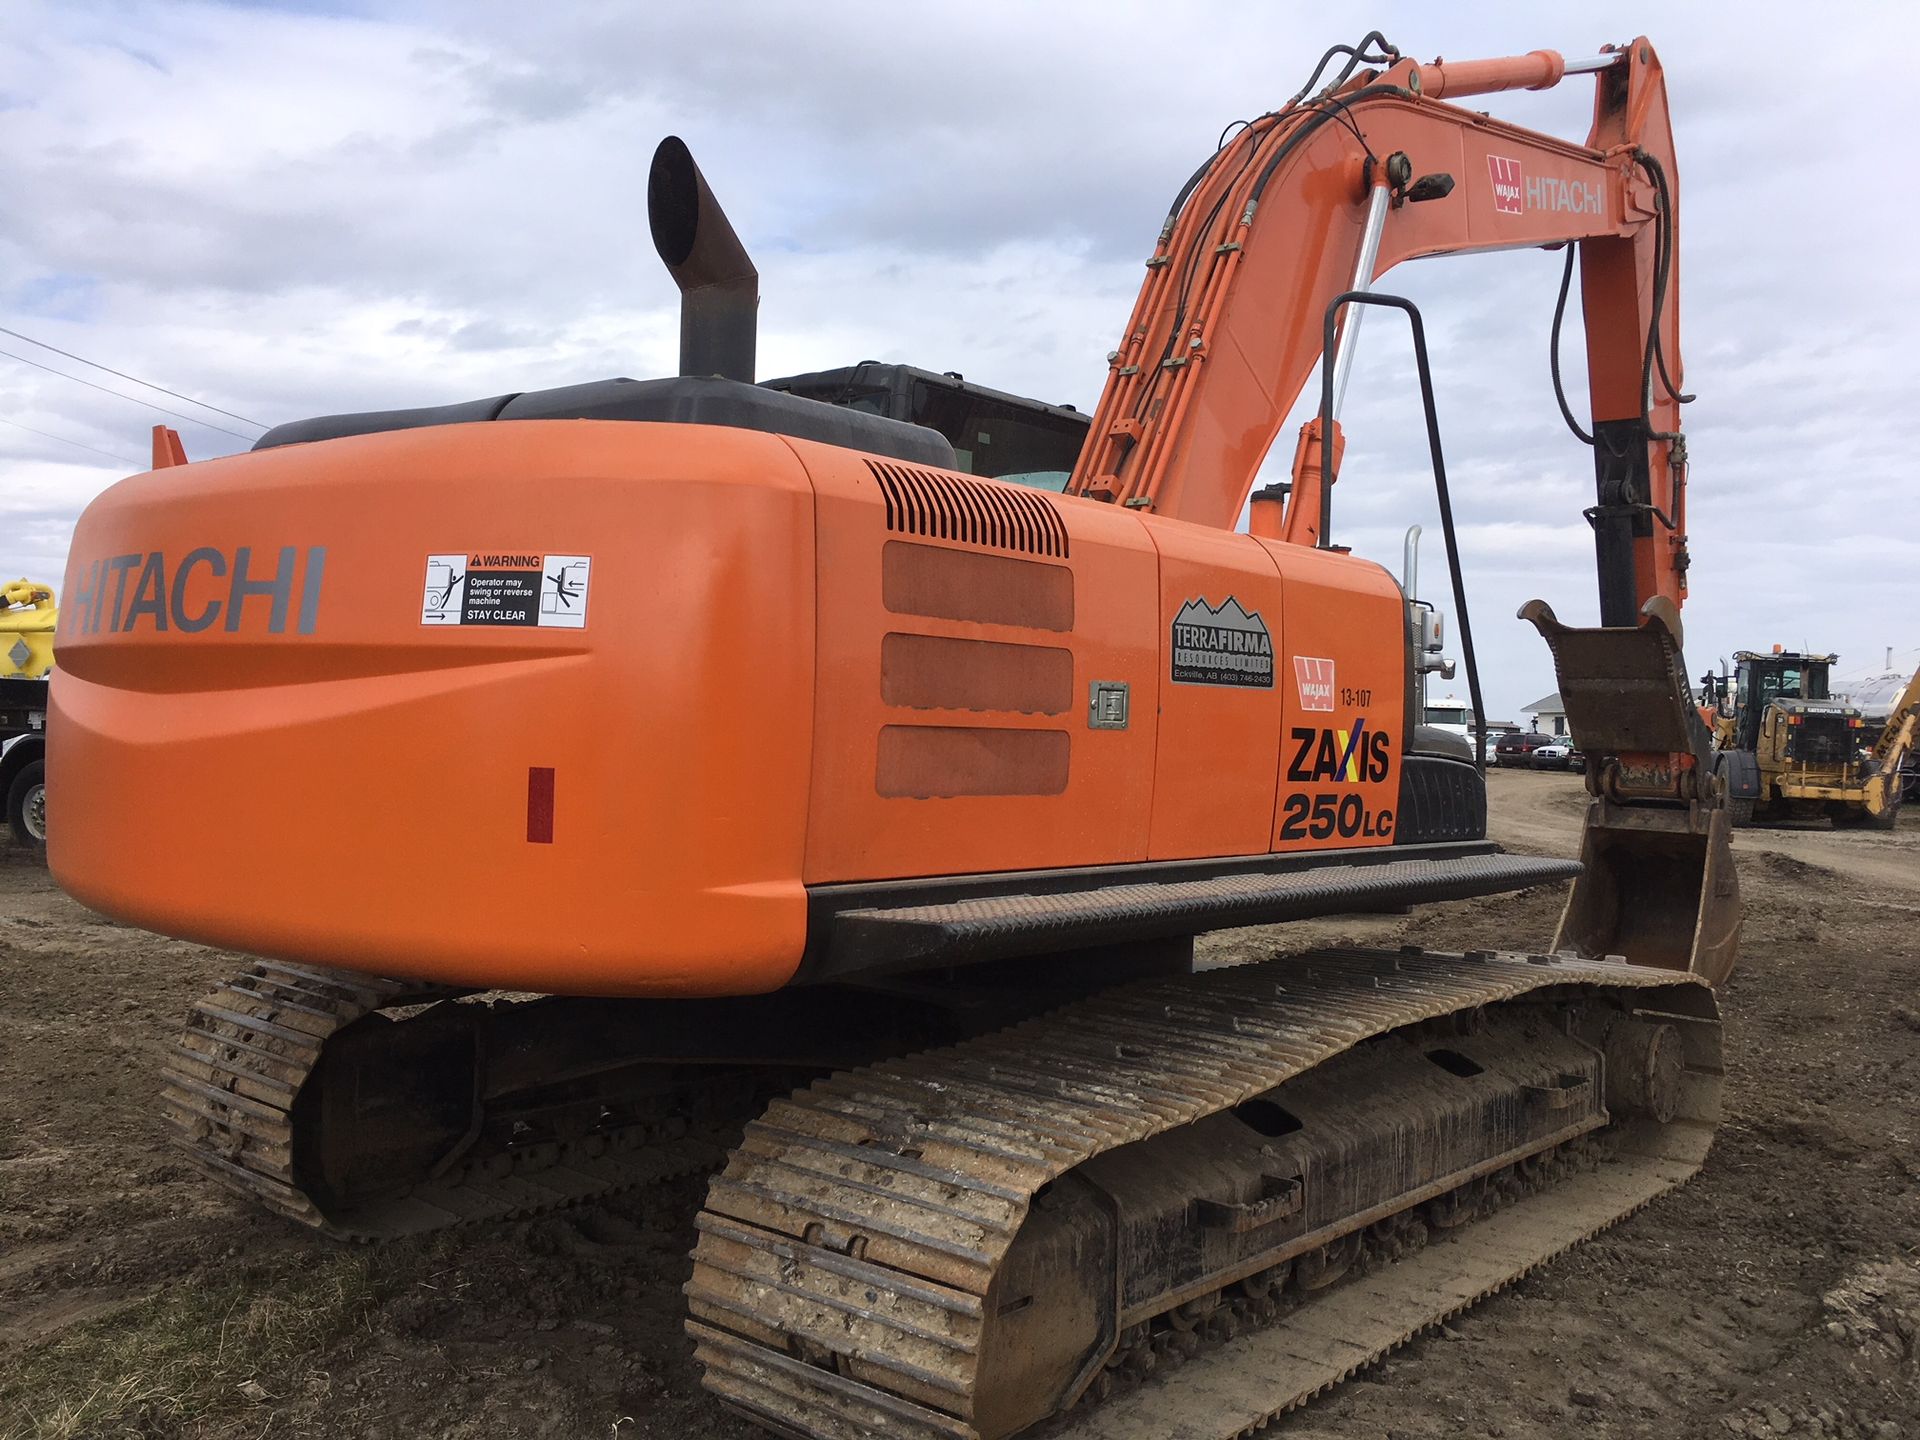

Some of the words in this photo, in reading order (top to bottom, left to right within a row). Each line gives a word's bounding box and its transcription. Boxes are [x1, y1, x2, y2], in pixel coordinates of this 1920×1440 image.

[1495, 183, 1520, 202] WAJAX
[1525, 176, 1602, 215] HITACHI
[483, 555, 540, 568] WARNING
[67, 546, 327, 635] HITACHI
[471, 578, 504, 587] Operator
[505, 579, 522, 587] may
[469, 588, 492, 597] swing
[503, 589, 533, 597] reverse
[469, 597, 501, 605] machine
[467, 610, 491, 620] STAY
[493, 611, 526, 621] CLEAR
[1175, 625, 1271, 654] TERRAFIRMA
[1177, 652, 1229, 666] RESOURCES
[1206, 672, 1218, 680] AB
[1220, 673, 1238, 682] (403)
[1302, 682, 1330, 700] WAJAX
[1341, 688, 1372, 708] 13-107
[1287, 718, 1390, 784] ZAXIS
